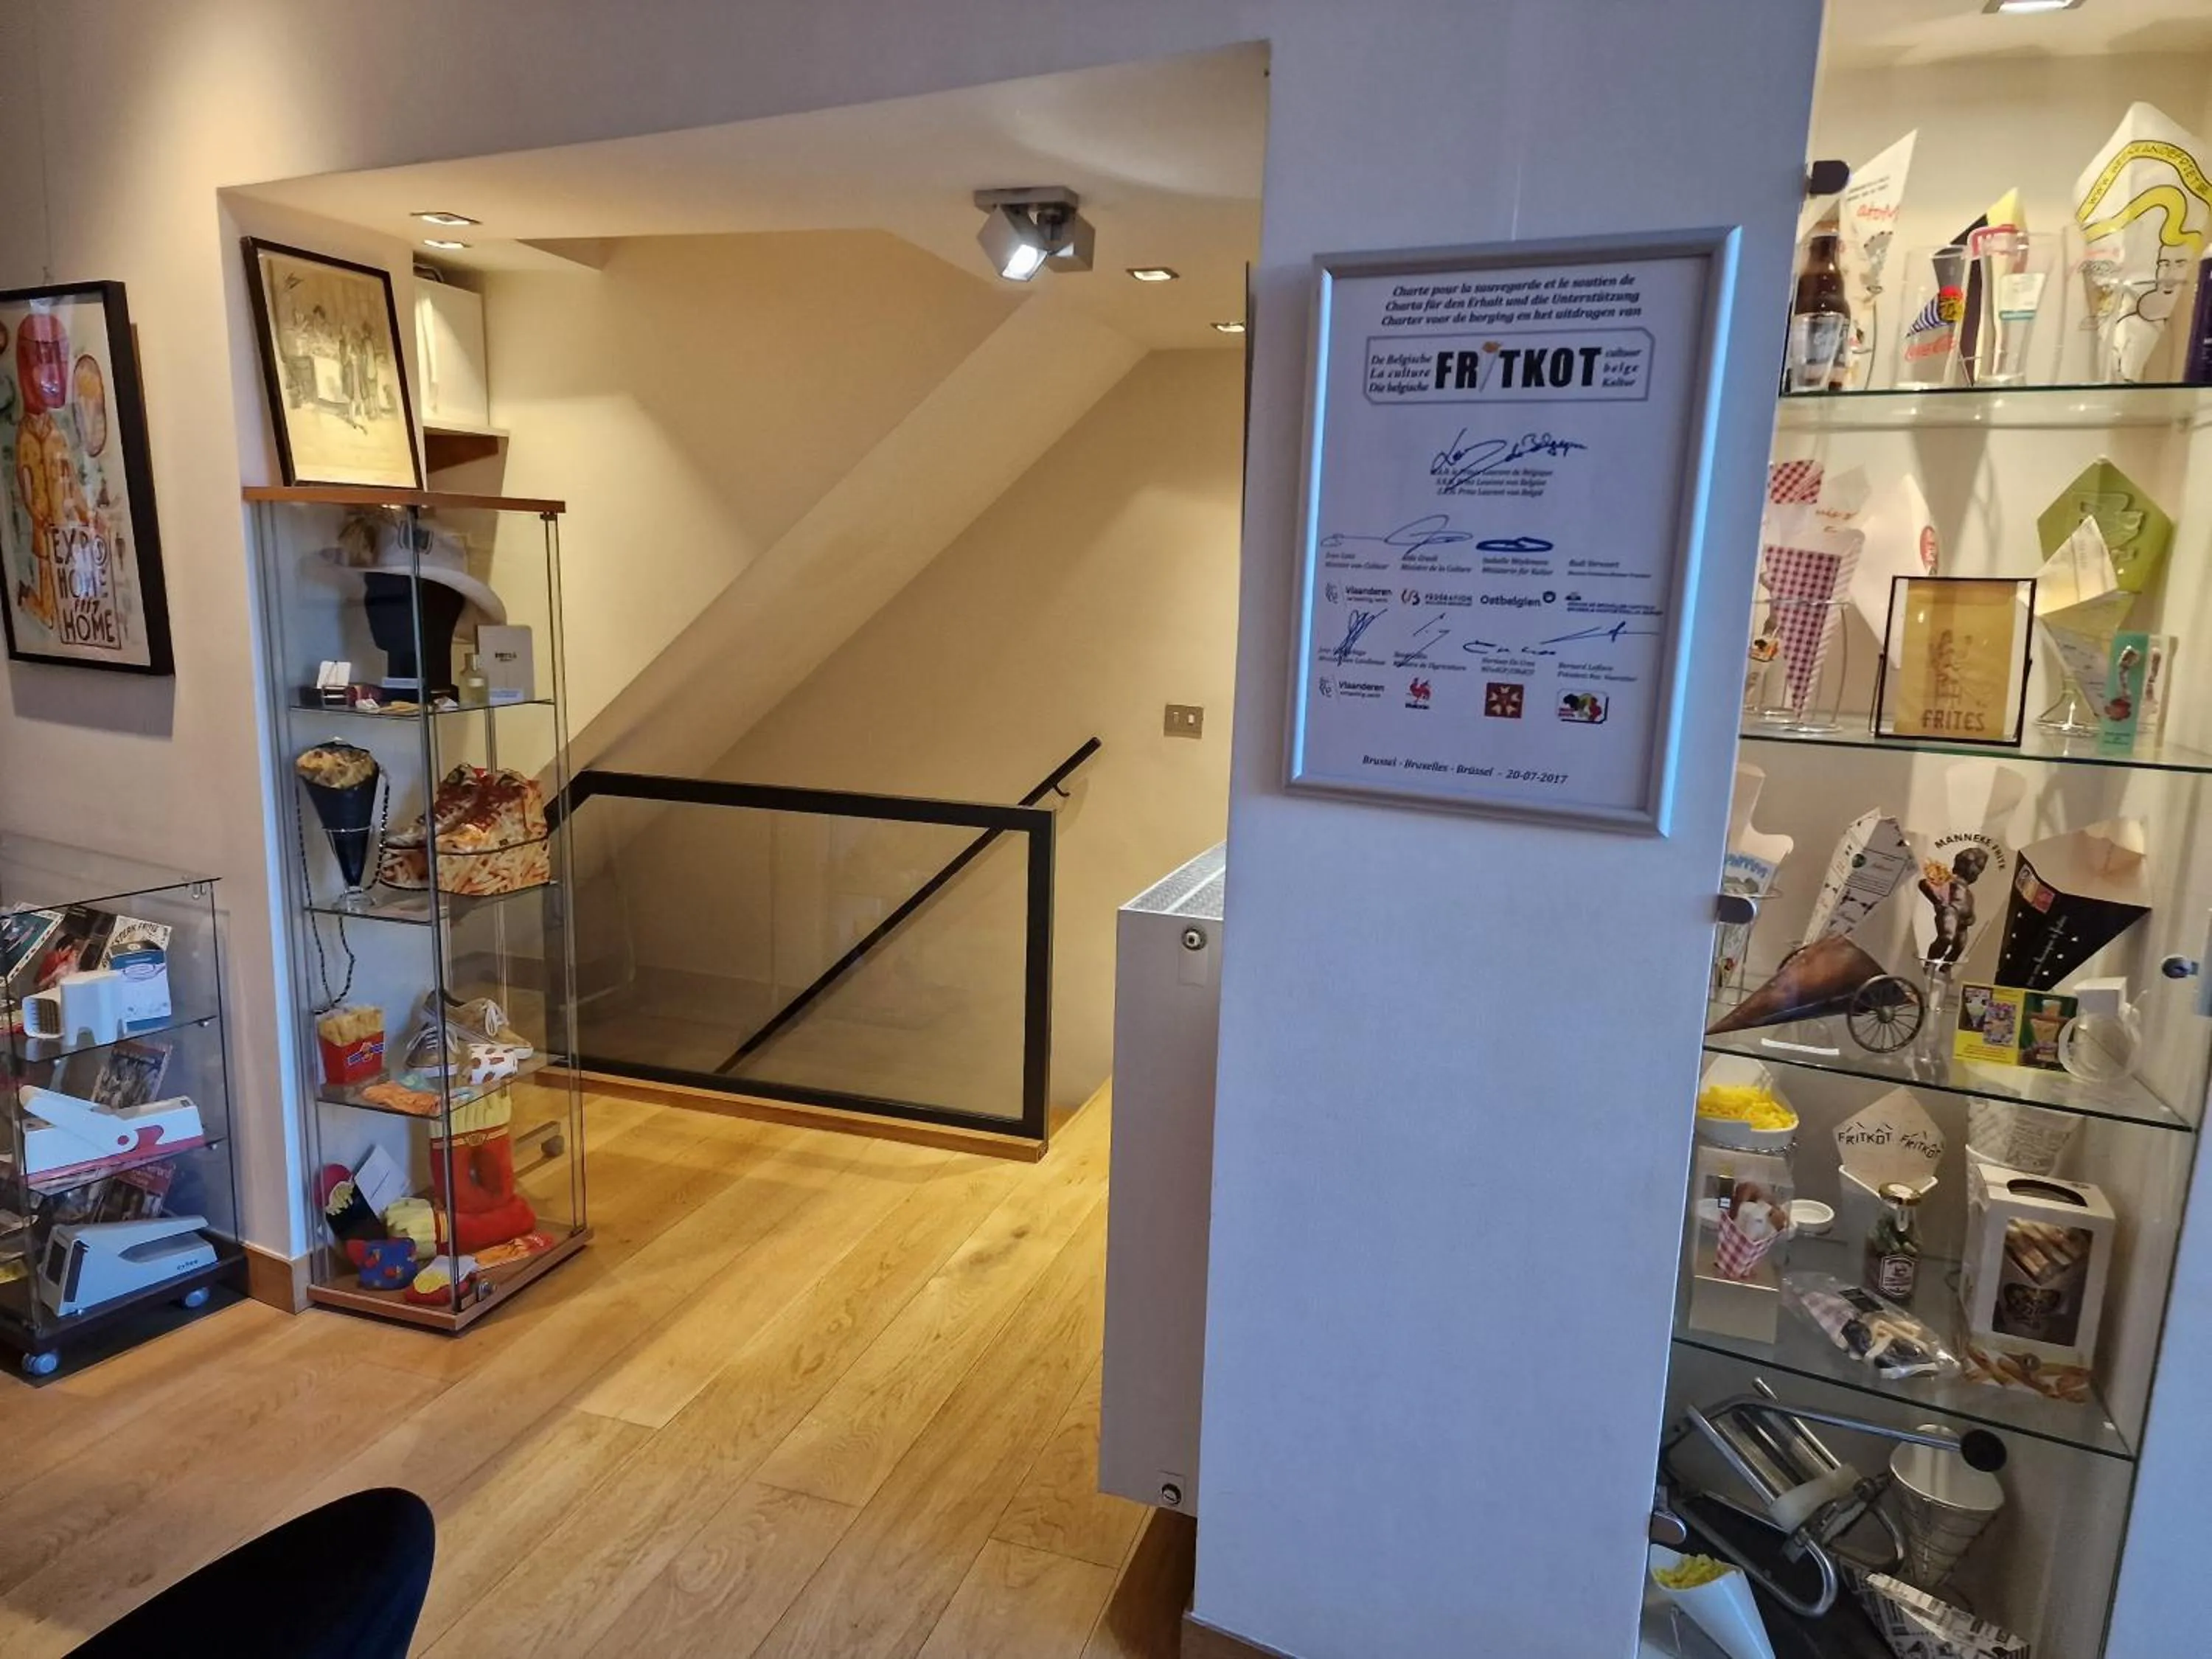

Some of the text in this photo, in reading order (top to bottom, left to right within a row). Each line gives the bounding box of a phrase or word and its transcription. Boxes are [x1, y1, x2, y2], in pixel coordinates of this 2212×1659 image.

[1393, 285, 1429, 296] Charte
[1430, 285, 1458, 296] pour
[1475, 279, 1542, 293] sauvegarde
[1544, 279, 1557, 289] et
[1572, 276, 1617, 288] soutien
[1619, 273, 1635, 285] de
[1423, 298, 1442, 313] für
[1444, 298, 1465, 309] den
[1467, 296, 1503, 307] Erhalt
[1505, 296, 1529, 306] und
[1530, 295, 1549, 305] die
[1381, 307, 1641, 326] Charter voor de borging en het uitdragen van
[1370, 366, 1431, 379] La culture
[1603, 362, 1640, 375] belge
[1480, 595, 1541, 608] Ostbelgien
[62, 609, 116, 643] HOME
[1339, 681, 1385, 692] Vlaanderen
[1920, 709, 1985, 731] FRITES
[1362, 754, 1569, 785] Brussel Bruxelles Brüssel 20-07-2017
